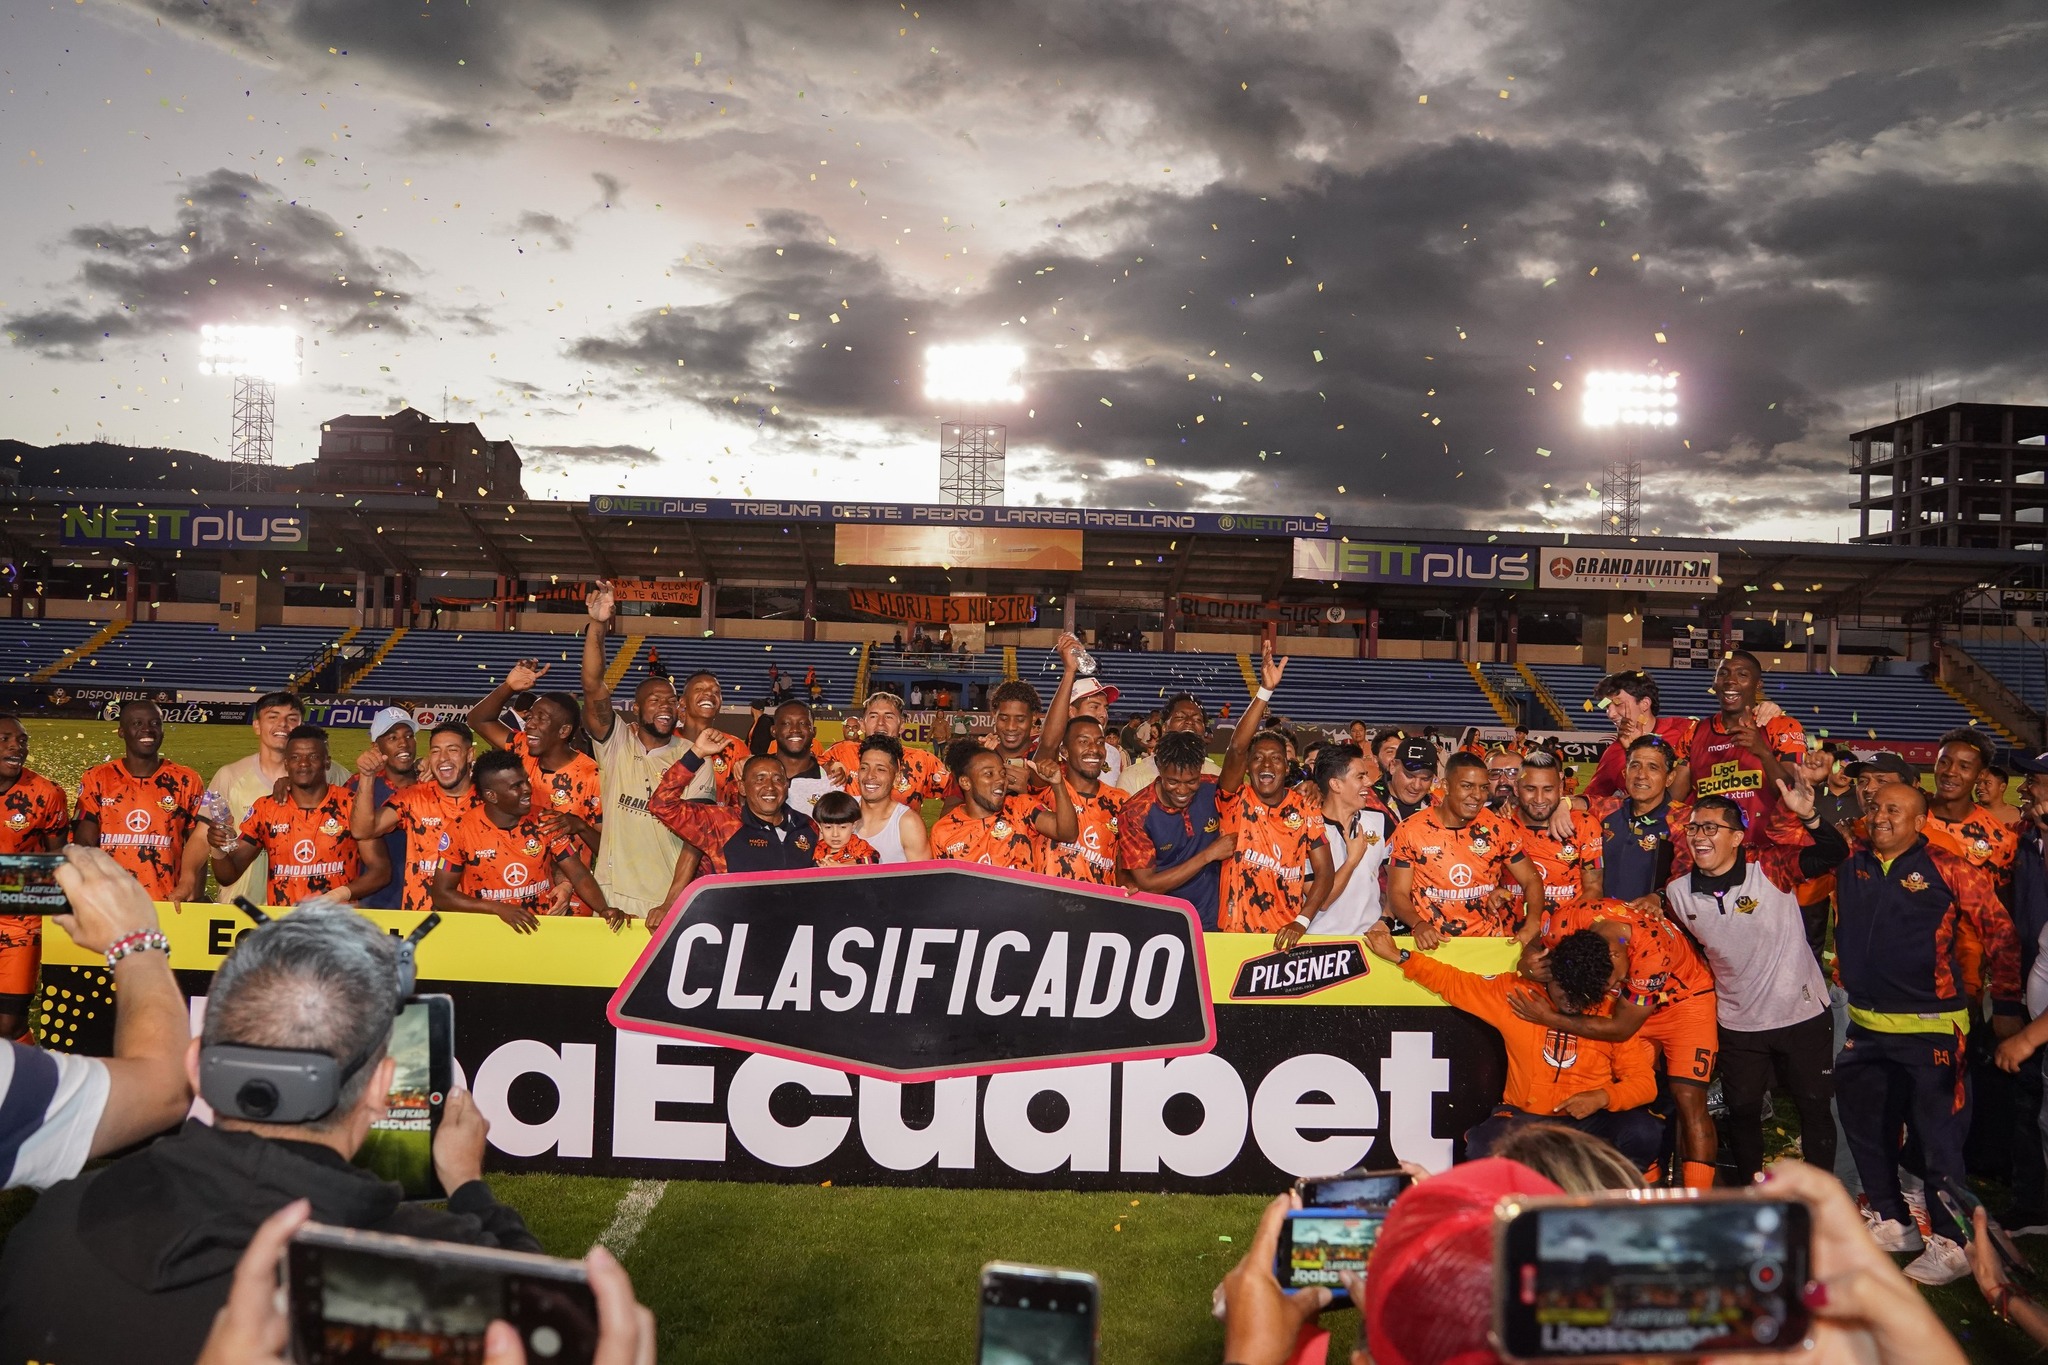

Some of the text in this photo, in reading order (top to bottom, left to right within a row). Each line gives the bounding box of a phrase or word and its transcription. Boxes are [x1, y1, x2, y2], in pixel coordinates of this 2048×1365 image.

[731, 502, 821, 517] TRIBUNA
[913, 507, 984, 522] PEDRO
[995, 509, 1080, 524] LARREA
[1085, 512, 1195, 529] ARELLANO
[634, 590, 645, 599] TE
[641, 582, 655, 590] LA
[852, 590, 1034, 623] LA GLORIA ES NUESTRA
[1279, 606, 1321, 623] SUR
[76, 689, 148, 702] DISPONIBLE
[1713, 763, 1736, 777] Liga
[1698, 773, 1759, 795] Ecuabet
[1731, 789, 1755, 799] xtrim
[667, 922, 1186, 1021] CLASIFICADO
[1249, 949, 1352, 993] PILSENER
[190, 996, 1454, 1178] aEcuabet
